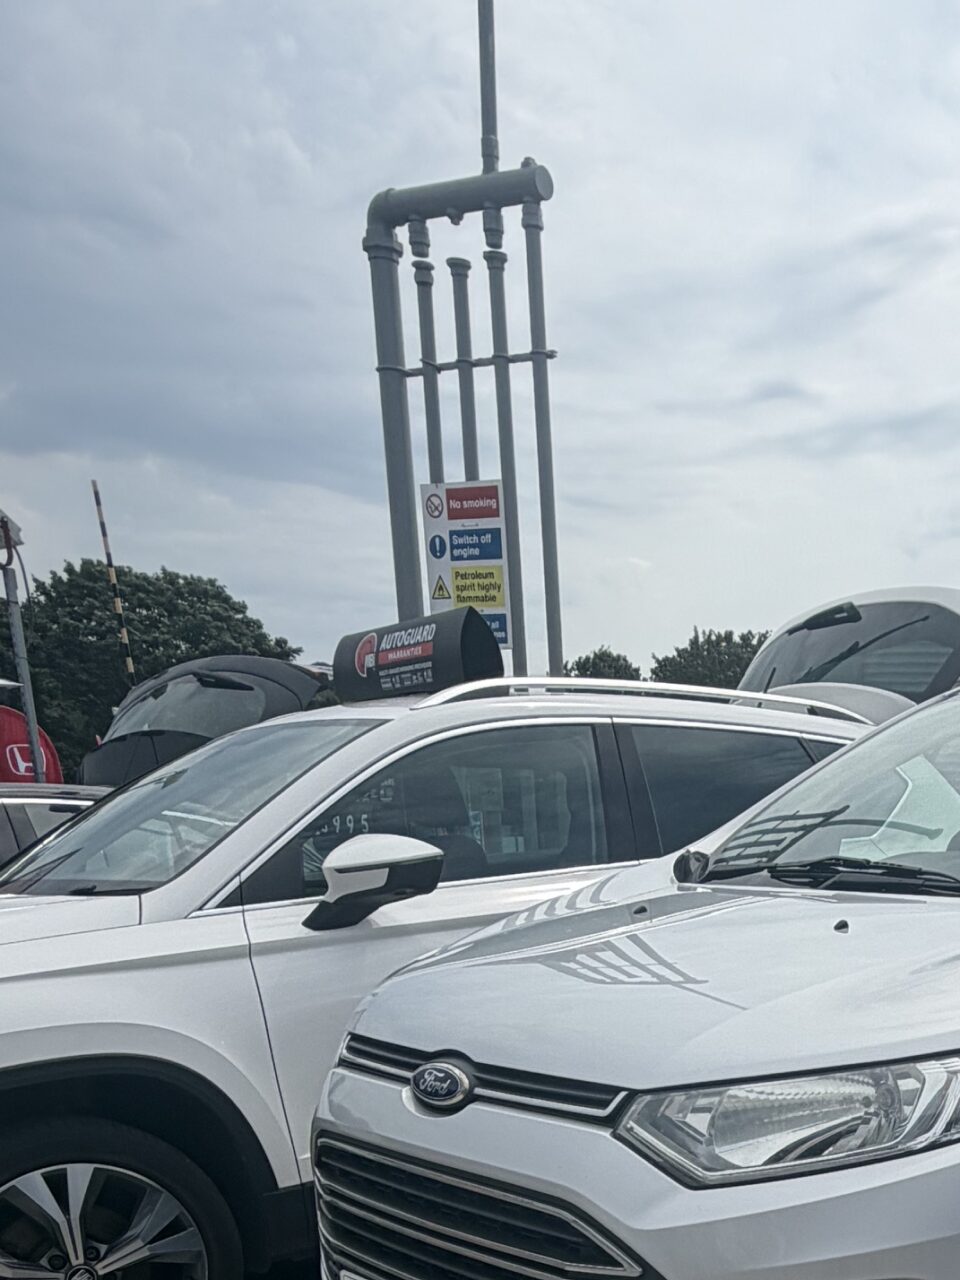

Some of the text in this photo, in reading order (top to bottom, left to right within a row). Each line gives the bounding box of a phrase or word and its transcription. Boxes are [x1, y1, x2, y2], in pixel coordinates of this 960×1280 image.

[450, 498, 497, 510] No smoking
[452, 533, 492, 545] Switch off
[453, 547, 480, 558] engine
[455, 571, 495, 581] Petroleum
[455, 581, 501, 593] spirit highly
[456, 593, 497, 603] flammable
[379, 623, 436, 651] AUTOGUARD
[419, 1069, 451, 1095] Ford
